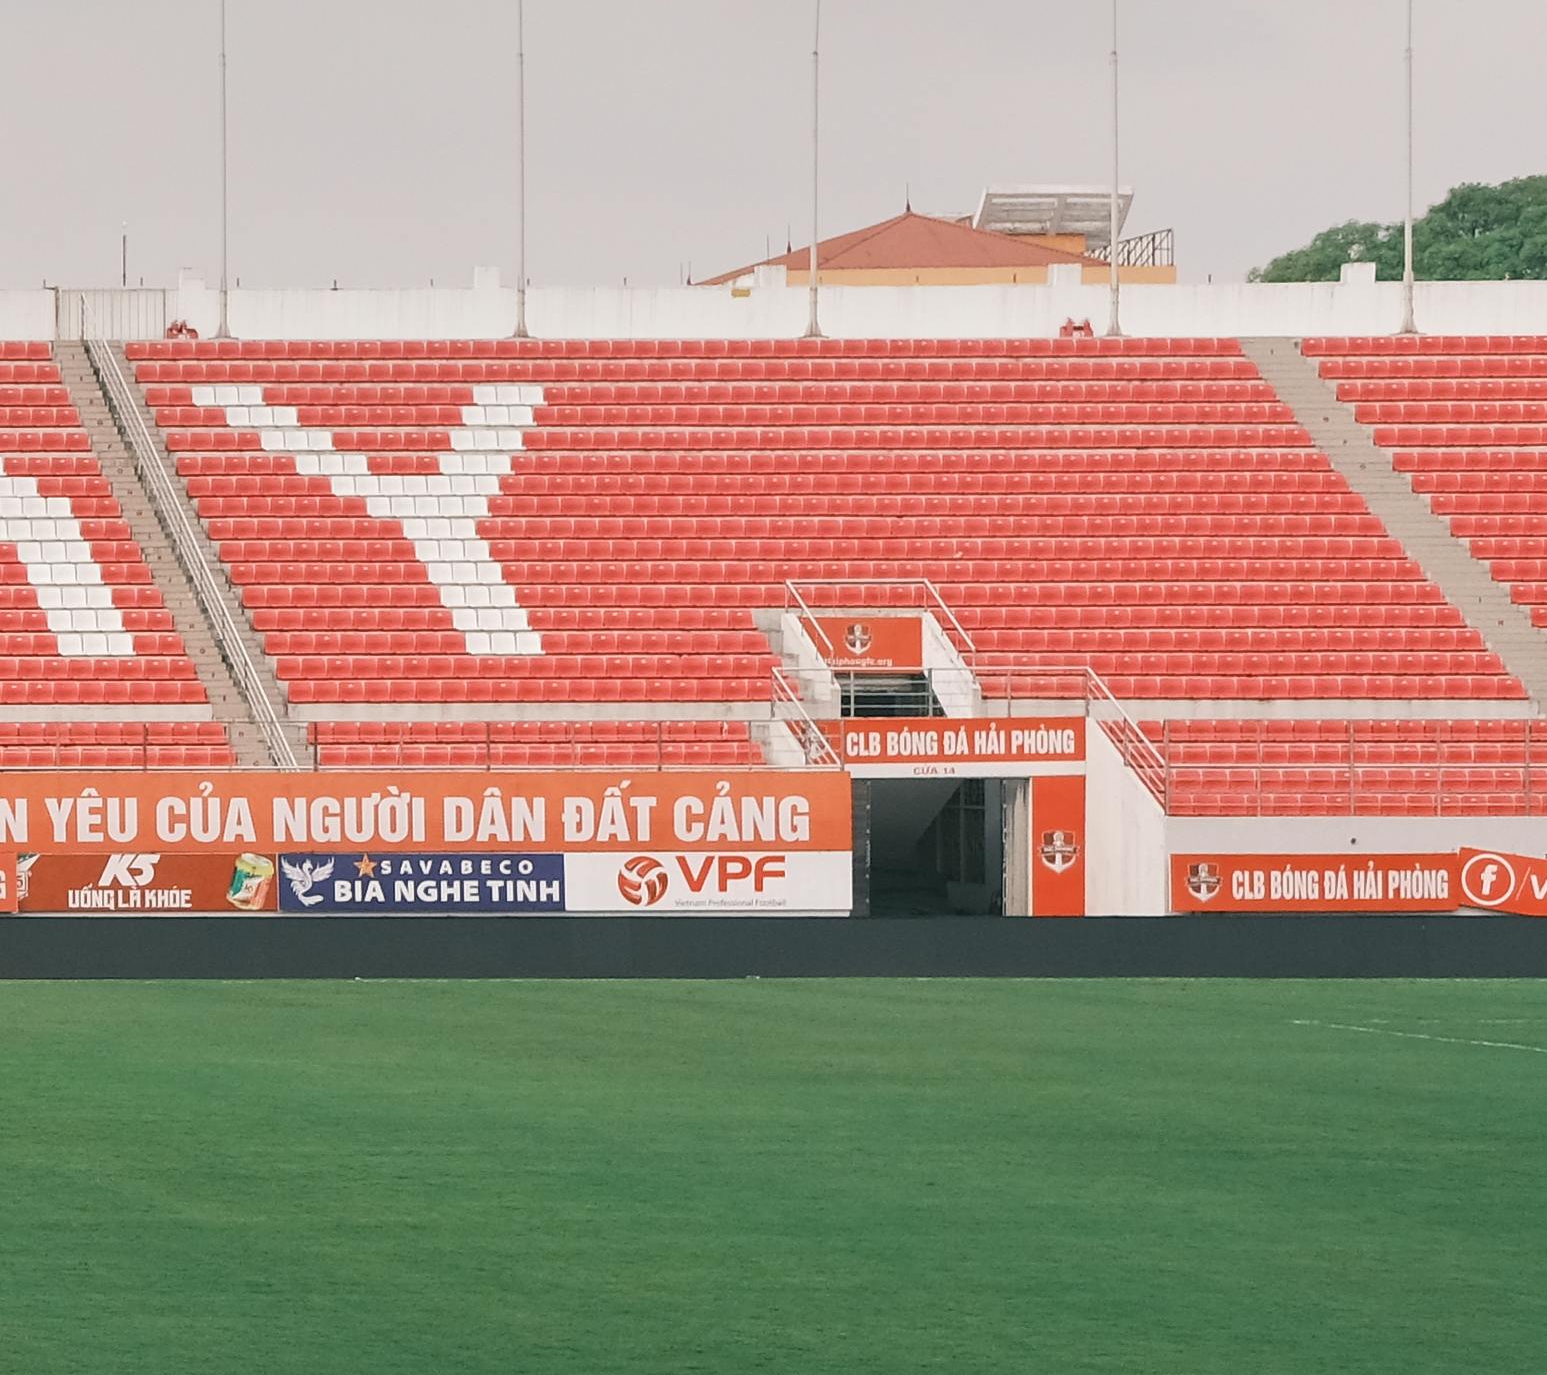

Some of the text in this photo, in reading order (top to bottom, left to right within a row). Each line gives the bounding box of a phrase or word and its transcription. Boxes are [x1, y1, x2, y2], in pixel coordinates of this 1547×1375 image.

[847, 723, 1074, 756] CLB BÓNG ĐÁ HẢI PHÒNG
[45, 788, 137, 842] YÊU
[157, 782, 256, 842] CỦA
[273, 786, 425, 842] NGƯỜI
[444, 787, 545, 841] DÂN
[562, 780, 656, 841] ĐẤT
[674, 781, 809, 841] CẢNG
[98, 854, 161, 887] K5
[381, 860, 533, 874] SAVABECO
[677, 855, 785, 892] VPF
[1232, 861, 1448, 899] CLB BÓNG ĐÁ HẢI PHÒNG
[68, 882, 142, 911] UỐNG LÀ
[334, 880, 560, 902] BIA NGHE TINH
